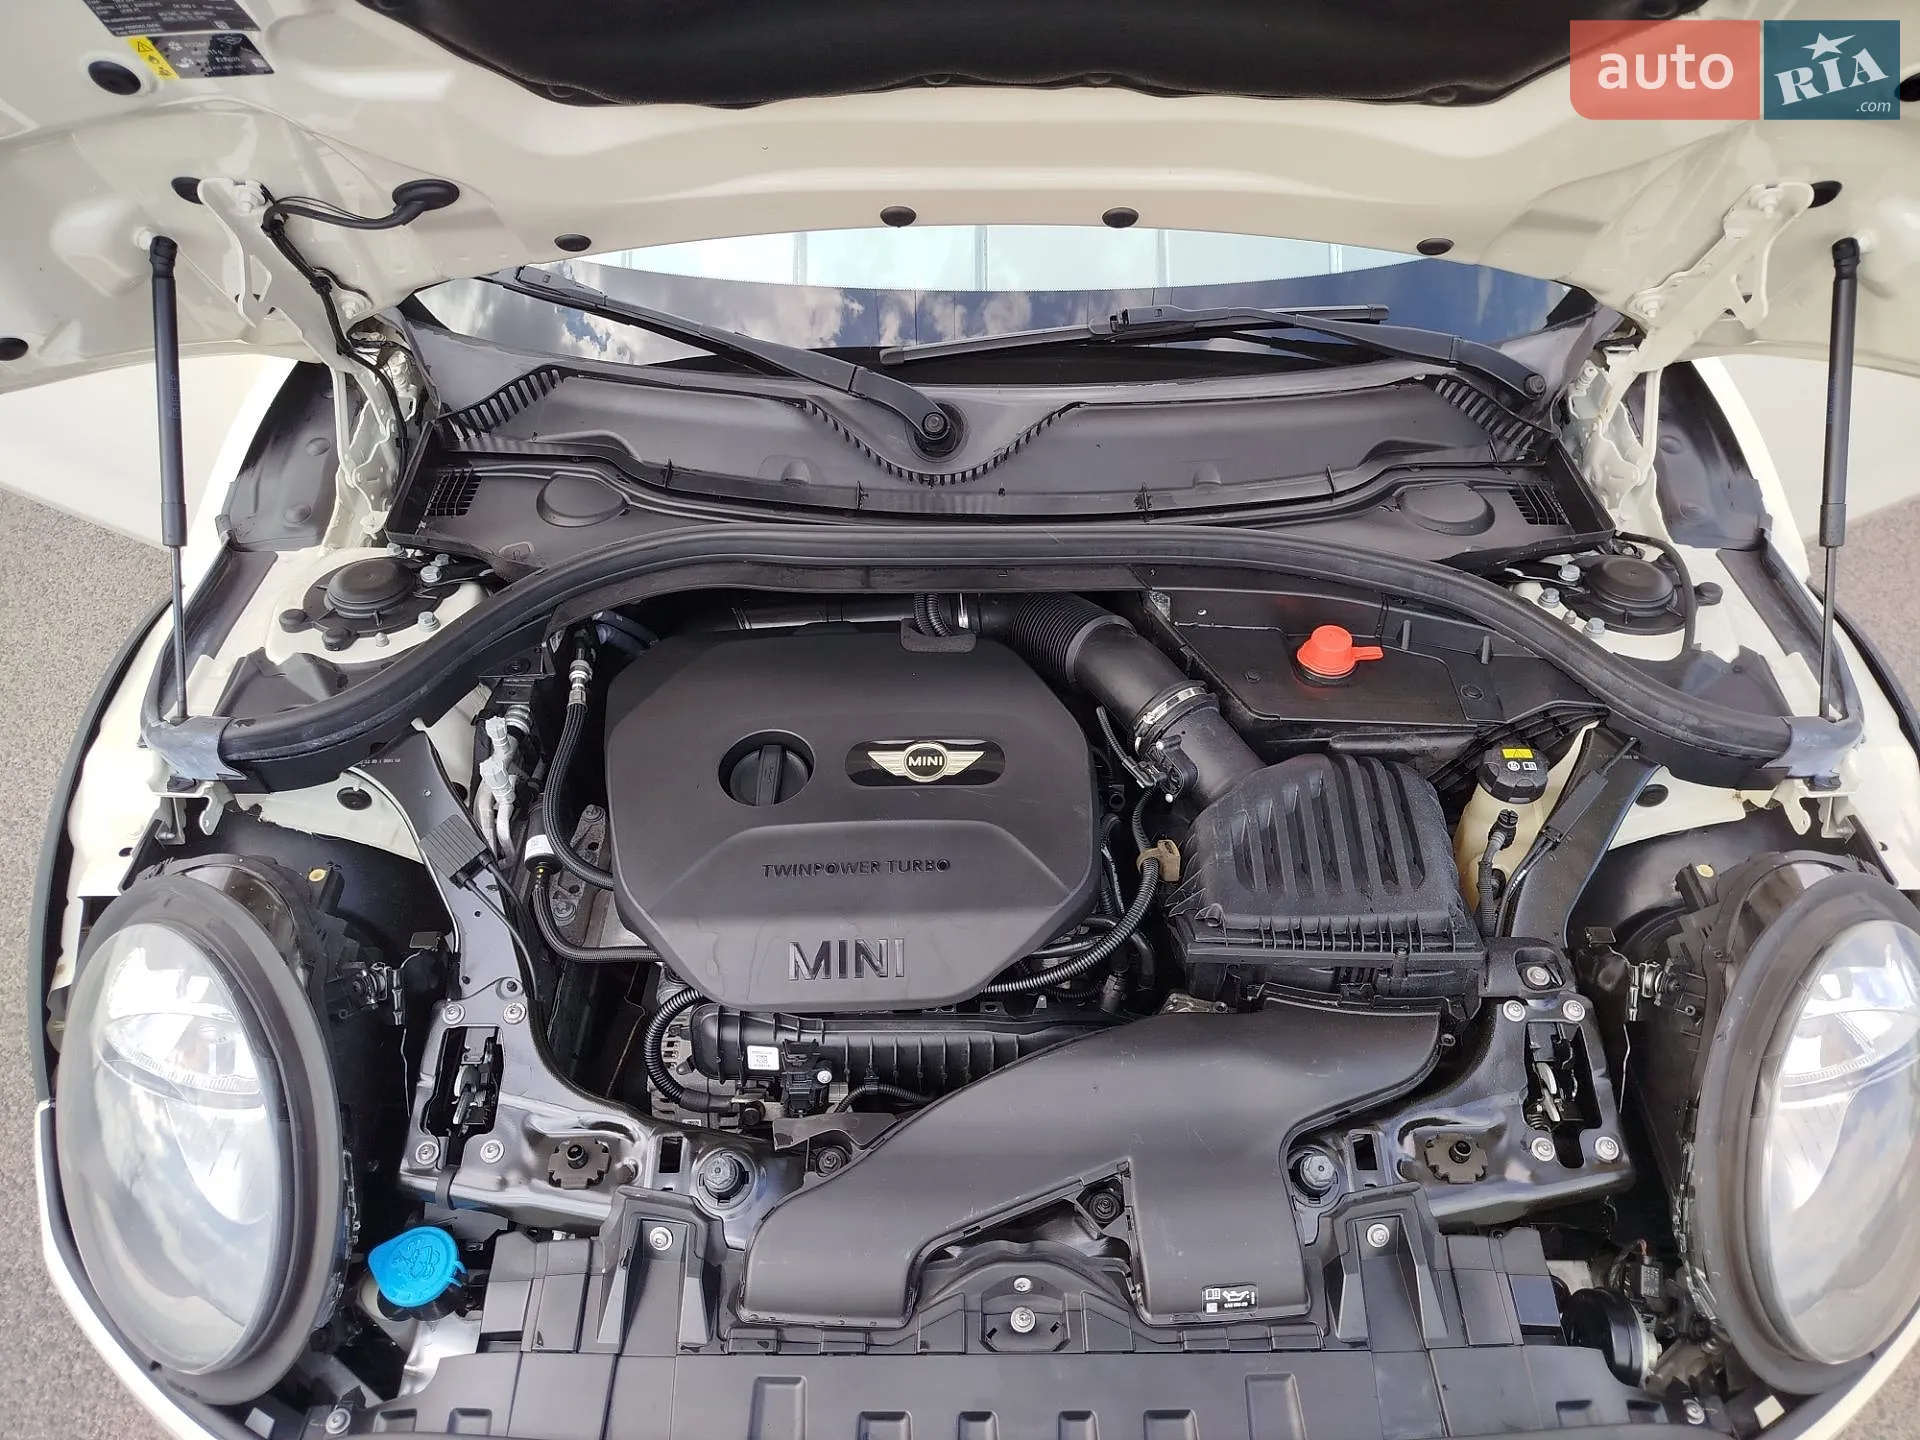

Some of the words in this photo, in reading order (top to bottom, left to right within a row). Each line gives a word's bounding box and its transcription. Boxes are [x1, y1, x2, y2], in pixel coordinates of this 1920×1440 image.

[908, 755, 943, 767] MINI
[762, 860, 881, 879] TWINPOWER
[886, 858, 951, 875] TURBO
[787, 937, 905, 981] MINI
